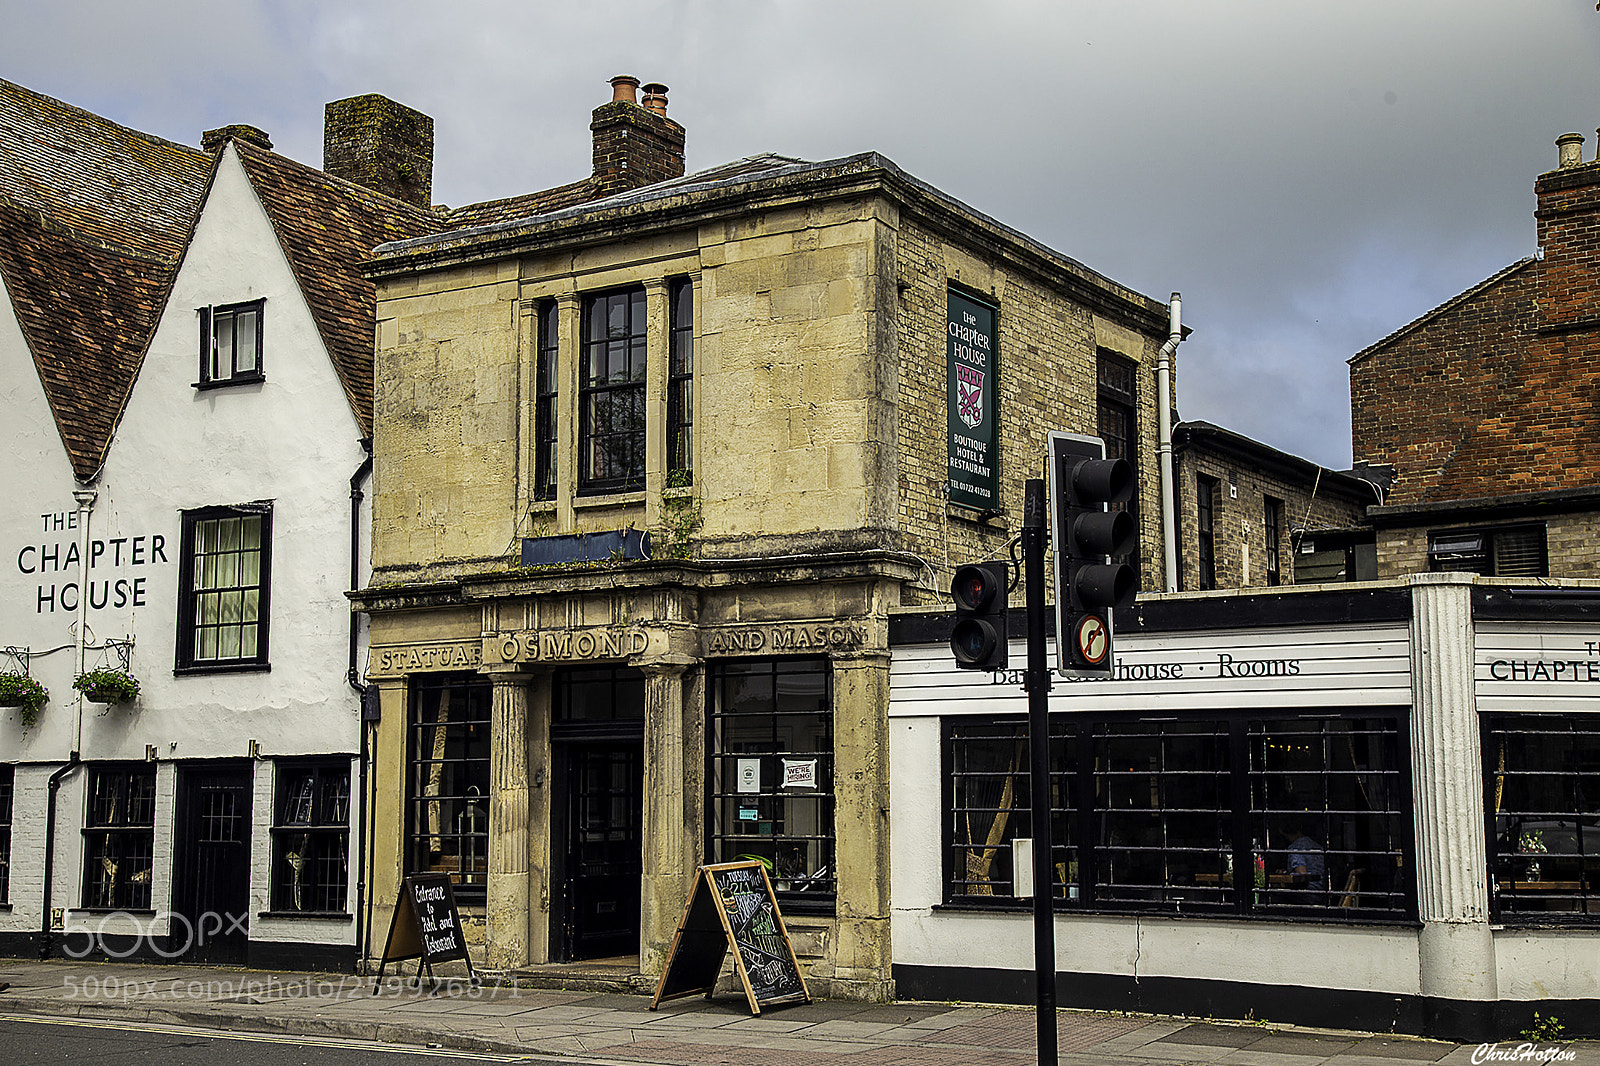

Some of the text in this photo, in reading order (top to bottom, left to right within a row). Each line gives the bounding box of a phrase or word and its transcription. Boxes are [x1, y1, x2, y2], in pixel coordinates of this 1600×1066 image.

[953, 433, 987, 453] BOUTIQUE
[957, 446, 984, 464] HOTEL &
[950, 456, 991, 478] RESTAURANT
[950, 479, 959, 489] TEL
[40, 511, 77, 532] THE
[18, 534, 168, 574] CHAPTER
[37, 577, 147, 614] HOUSE
[501, 630, 649, 661] OSMOND
[709, 626, 869, 652] AND MASON
[1217, 653, 1301, 678] Rooms
[415, 885, 446, 903] Entrance
[439, 909, 454, 930] and
